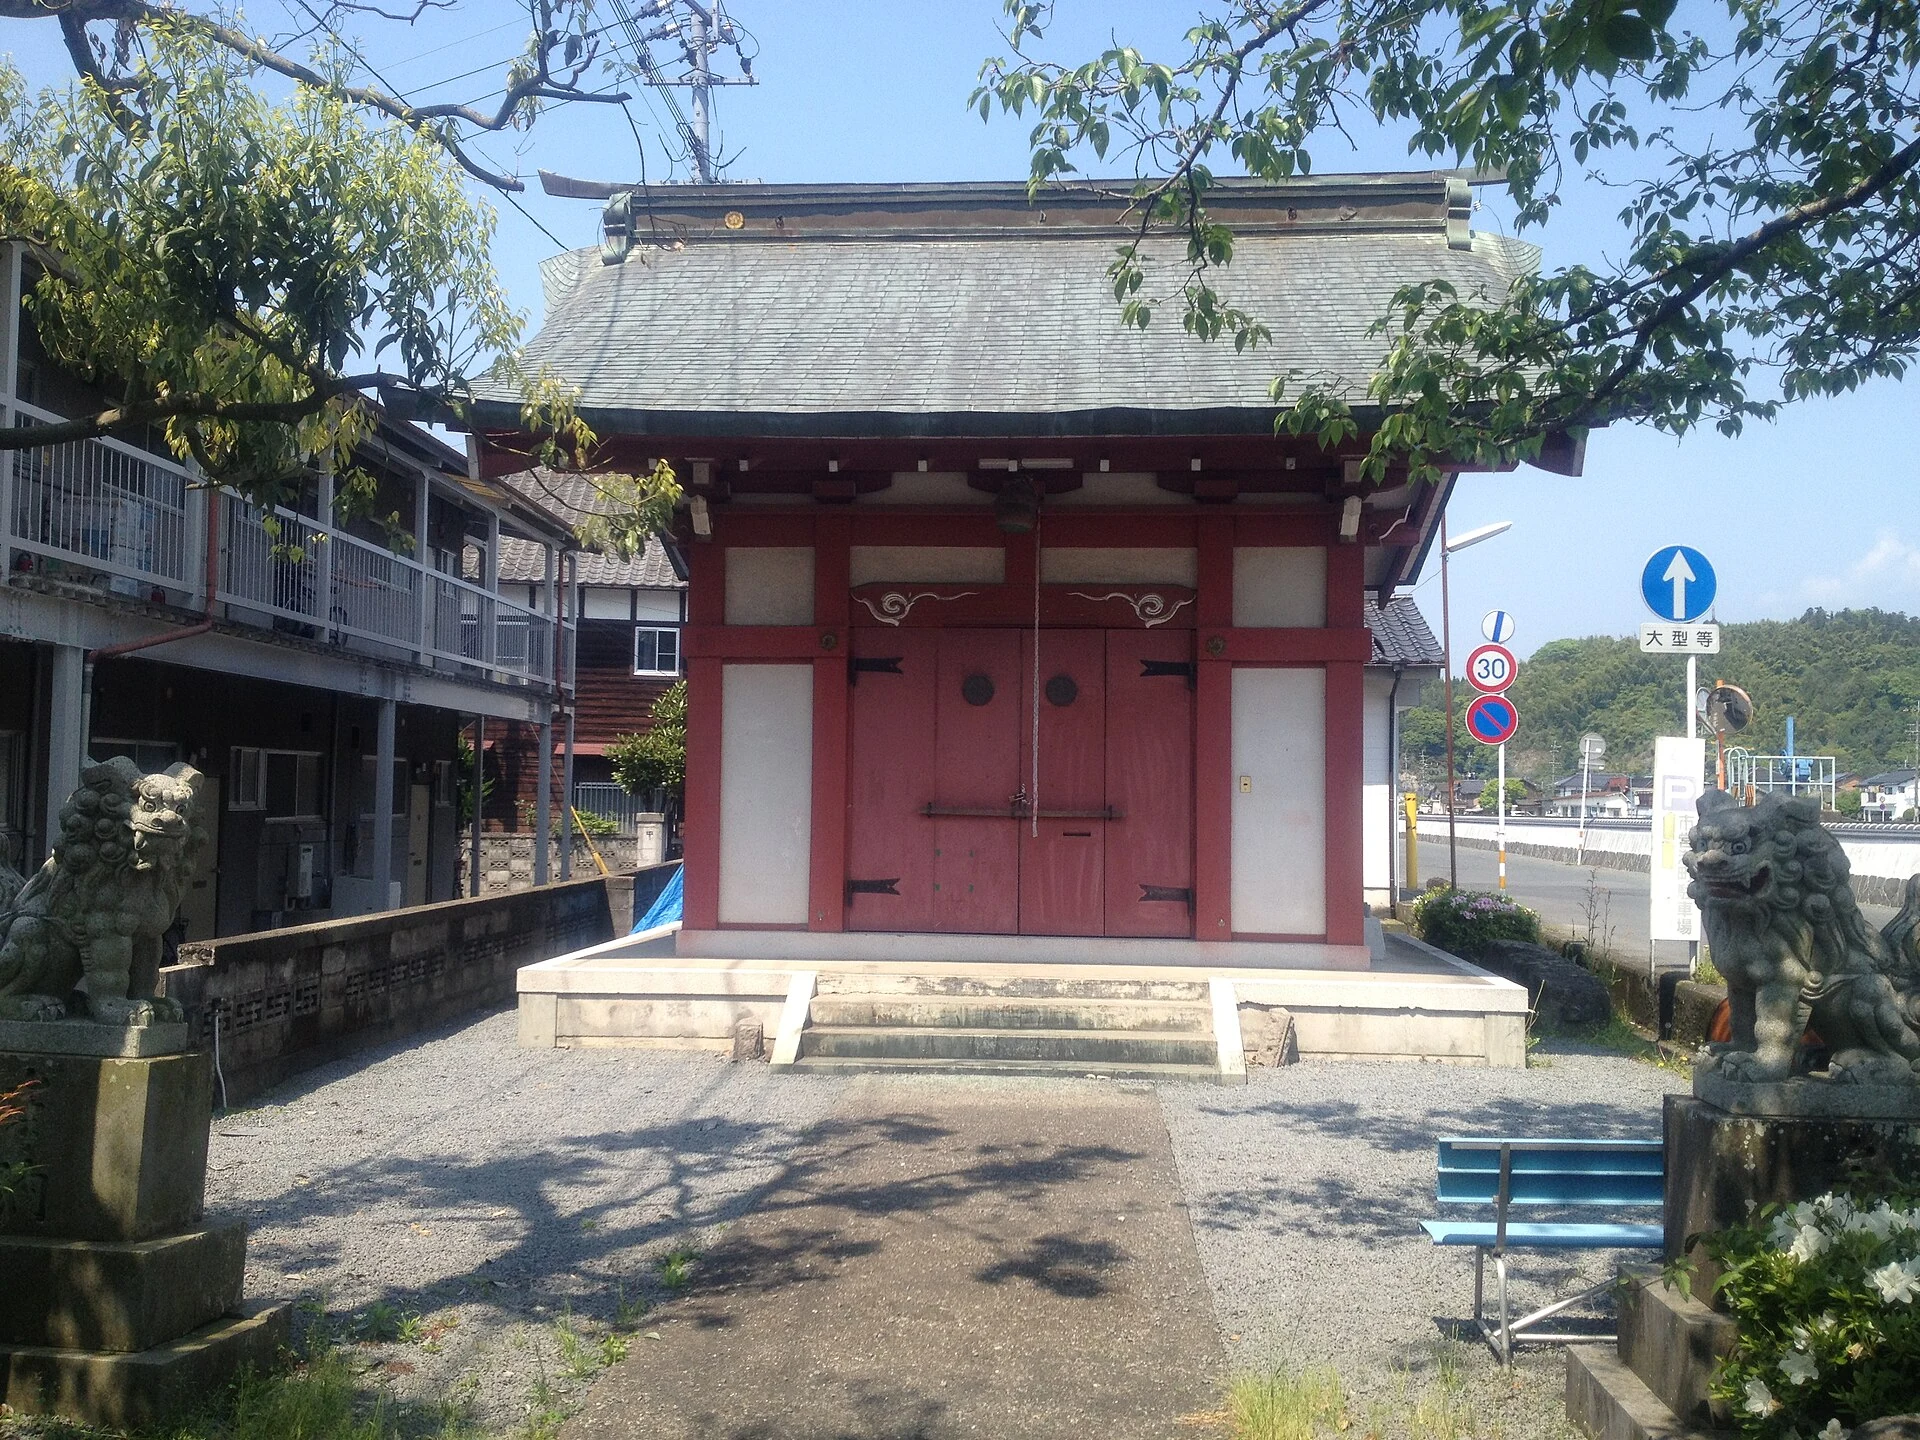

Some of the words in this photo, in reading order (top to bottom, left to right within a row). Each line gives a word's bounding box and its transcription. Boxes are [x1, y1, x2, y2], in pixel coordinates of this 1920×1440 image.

[1646, 630, 1713, 648] 大型等
[1477, 658, 1505, 679] 30
[1663, 777, 1696, 809] P
